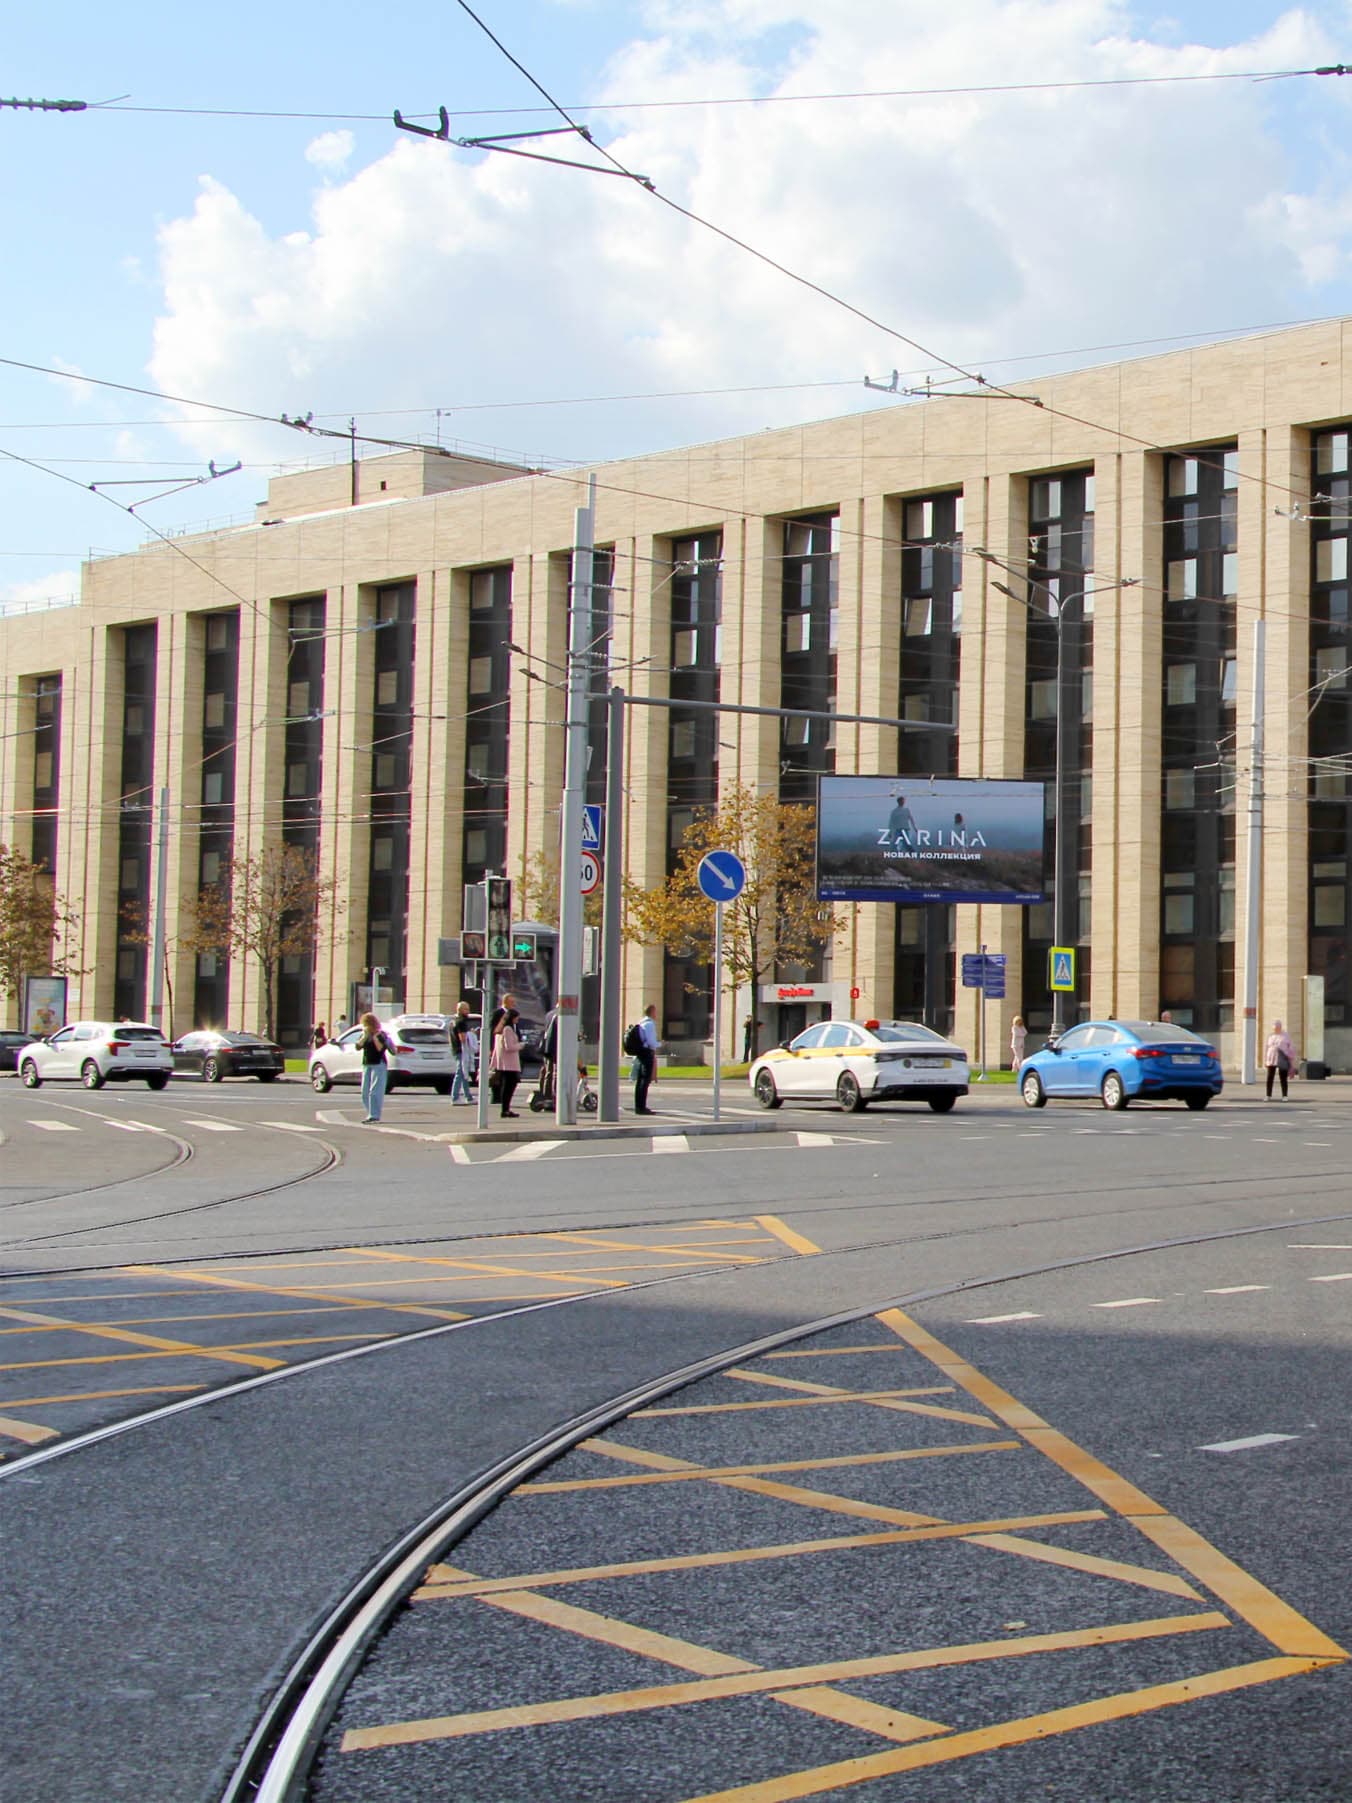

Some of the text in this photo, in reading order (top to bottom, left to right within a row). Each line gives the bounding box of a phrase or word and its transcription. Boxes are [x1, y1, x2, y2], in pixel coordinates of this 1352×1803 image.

[876, 828, 987, 848] ZARINA
[883, 850, 982, 862] НОВАЯ КОЛЛЕКЦИЯ
